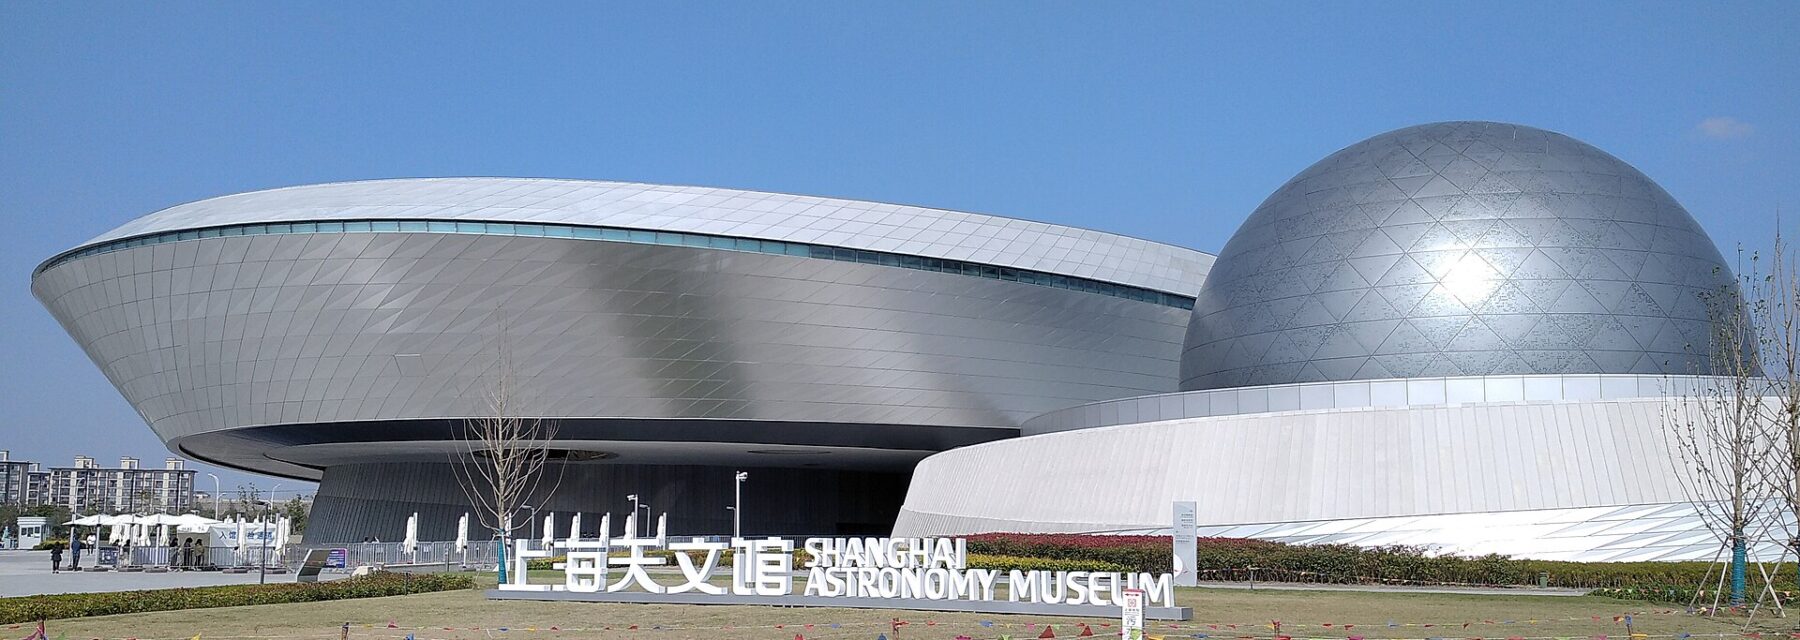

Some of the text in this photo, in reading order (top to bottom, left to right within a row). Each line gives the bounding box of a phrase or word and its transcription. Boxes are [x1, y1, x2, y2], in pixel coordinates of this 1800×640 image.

[219, 531, 273, 540] 入馆检通道
[804, 537, 967, 569] SHANGHAI
[498, 536, 794, 596] 上海天文馆
[804, 567, 1175, 608] ASTRONOMY MUSEUM
